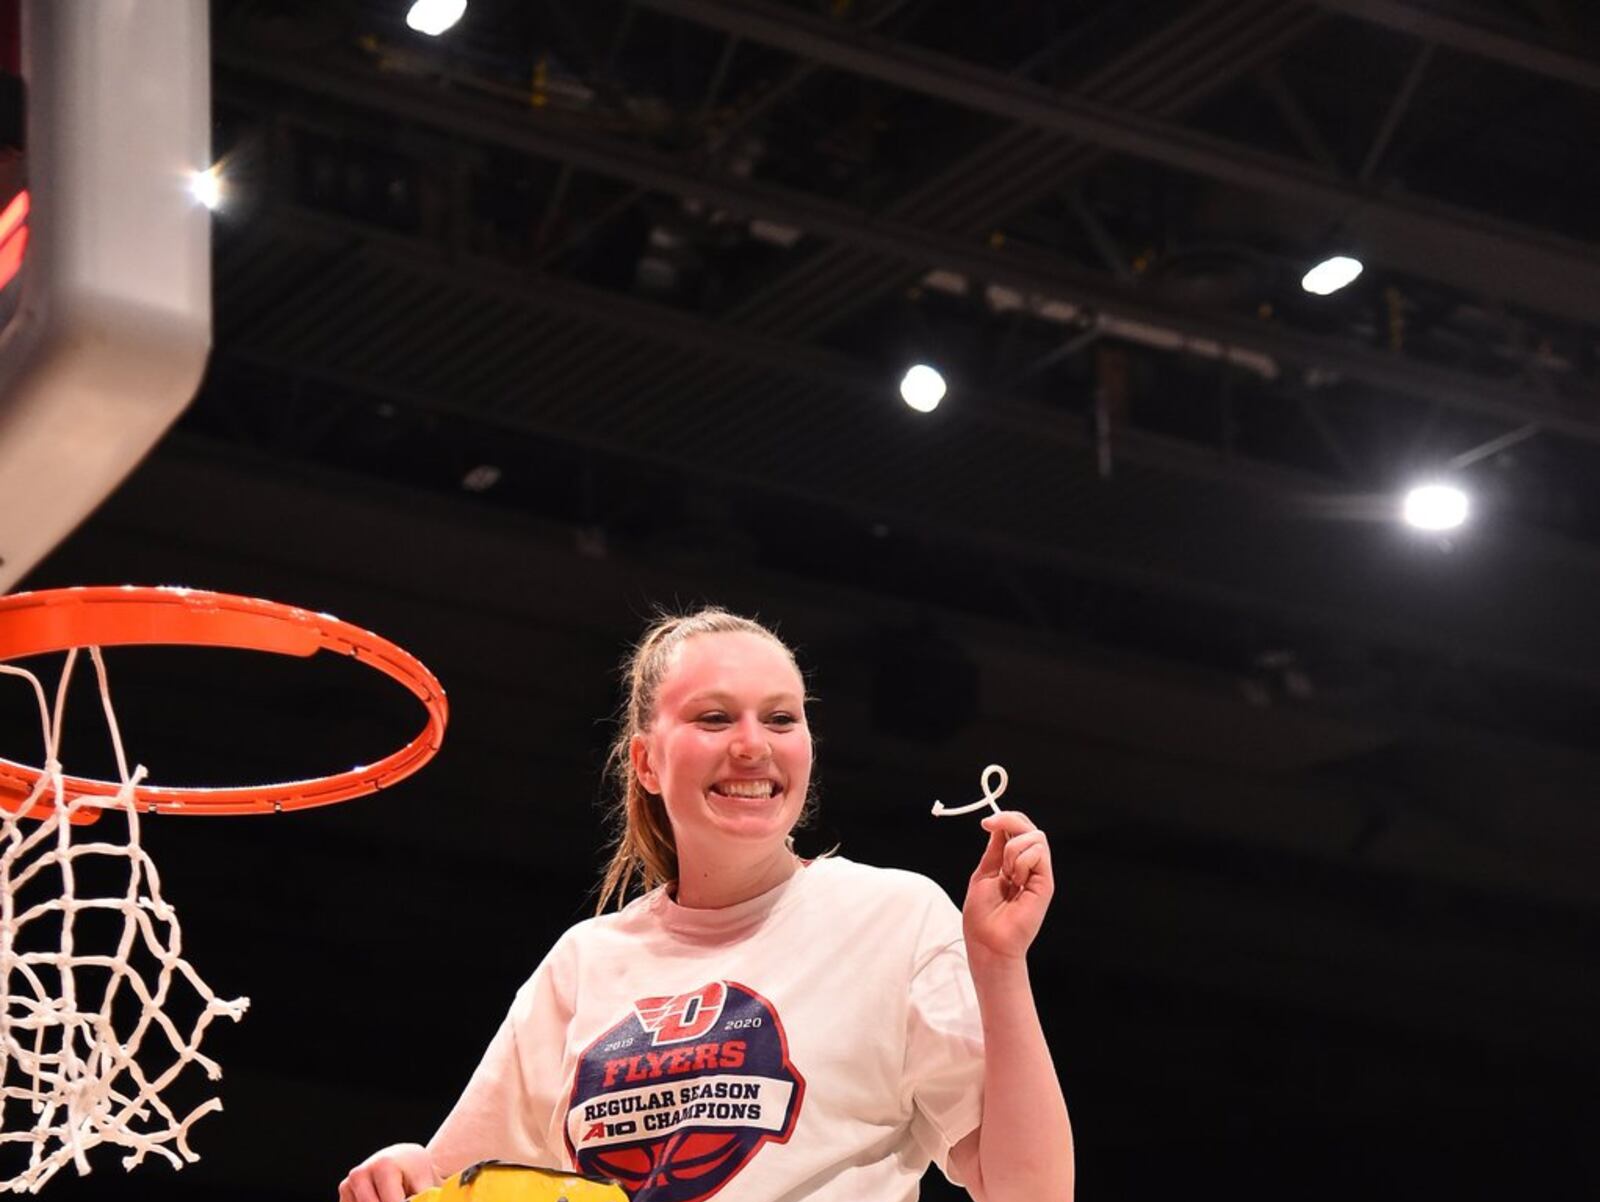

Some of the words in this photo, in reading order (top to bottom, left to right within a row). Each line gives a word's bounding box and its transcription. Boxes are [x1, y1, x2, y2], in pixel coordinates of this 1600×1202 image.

[724, 1017, 762, 1031] 2020
[604, 1037, 634, 1052] 2019
[603, 1041, 746, 1087] FLYERS
[584, 1090, 675, 1121] REGULAR
[680, 1082, 760, 1104] SEASON
[643, 1103, 761, 1131] CHAMPIONS
